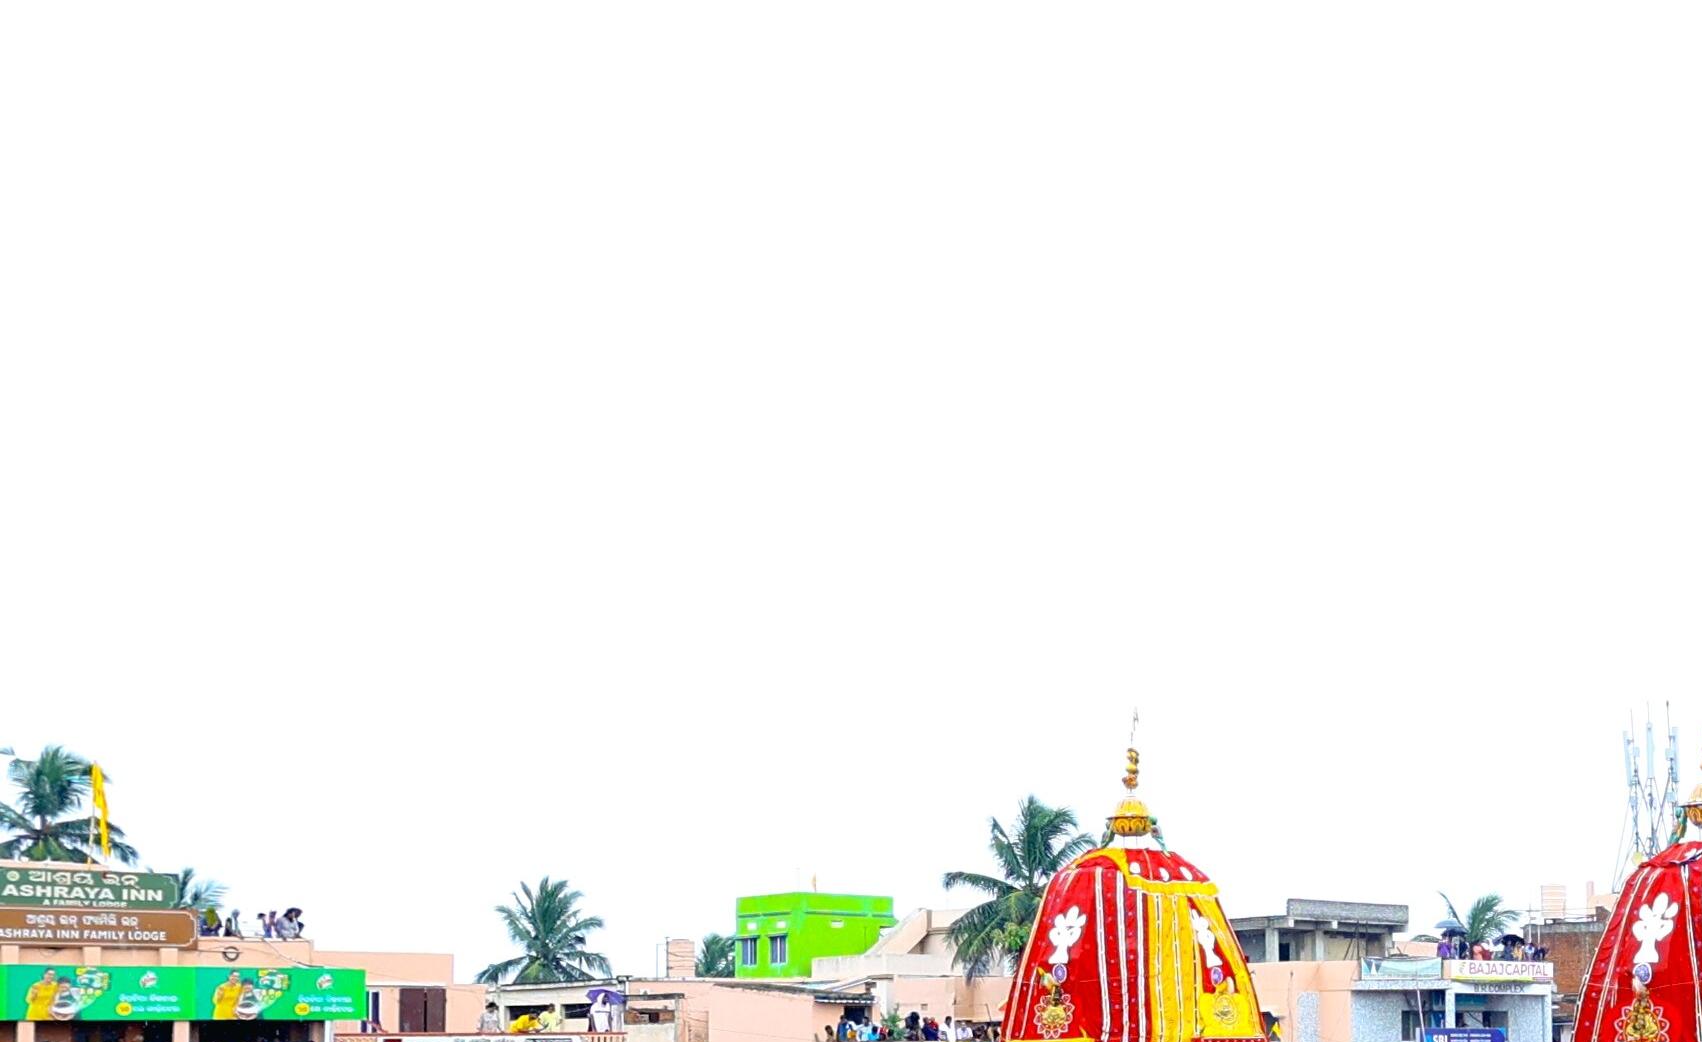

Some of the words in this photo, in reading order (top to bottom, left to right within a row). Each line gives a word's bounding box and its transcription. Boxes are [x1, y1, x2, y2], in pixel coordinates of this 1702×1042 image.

[2, 884, 115, 900] ASHRAYA
[122, 889, 163, 901] INN
[53, 899, 90, 907] FAMILY
[0, 928, 53, 938] ASHRAYA
[57, 929, 80, 939] INN
[83, 930, 125, 940] FAMILY
[128, 931, 167, 941] LODGE
[1469, 963, 1504, 975] BAJAJ
[1505, 964, 1548, 976] CAPITAL
